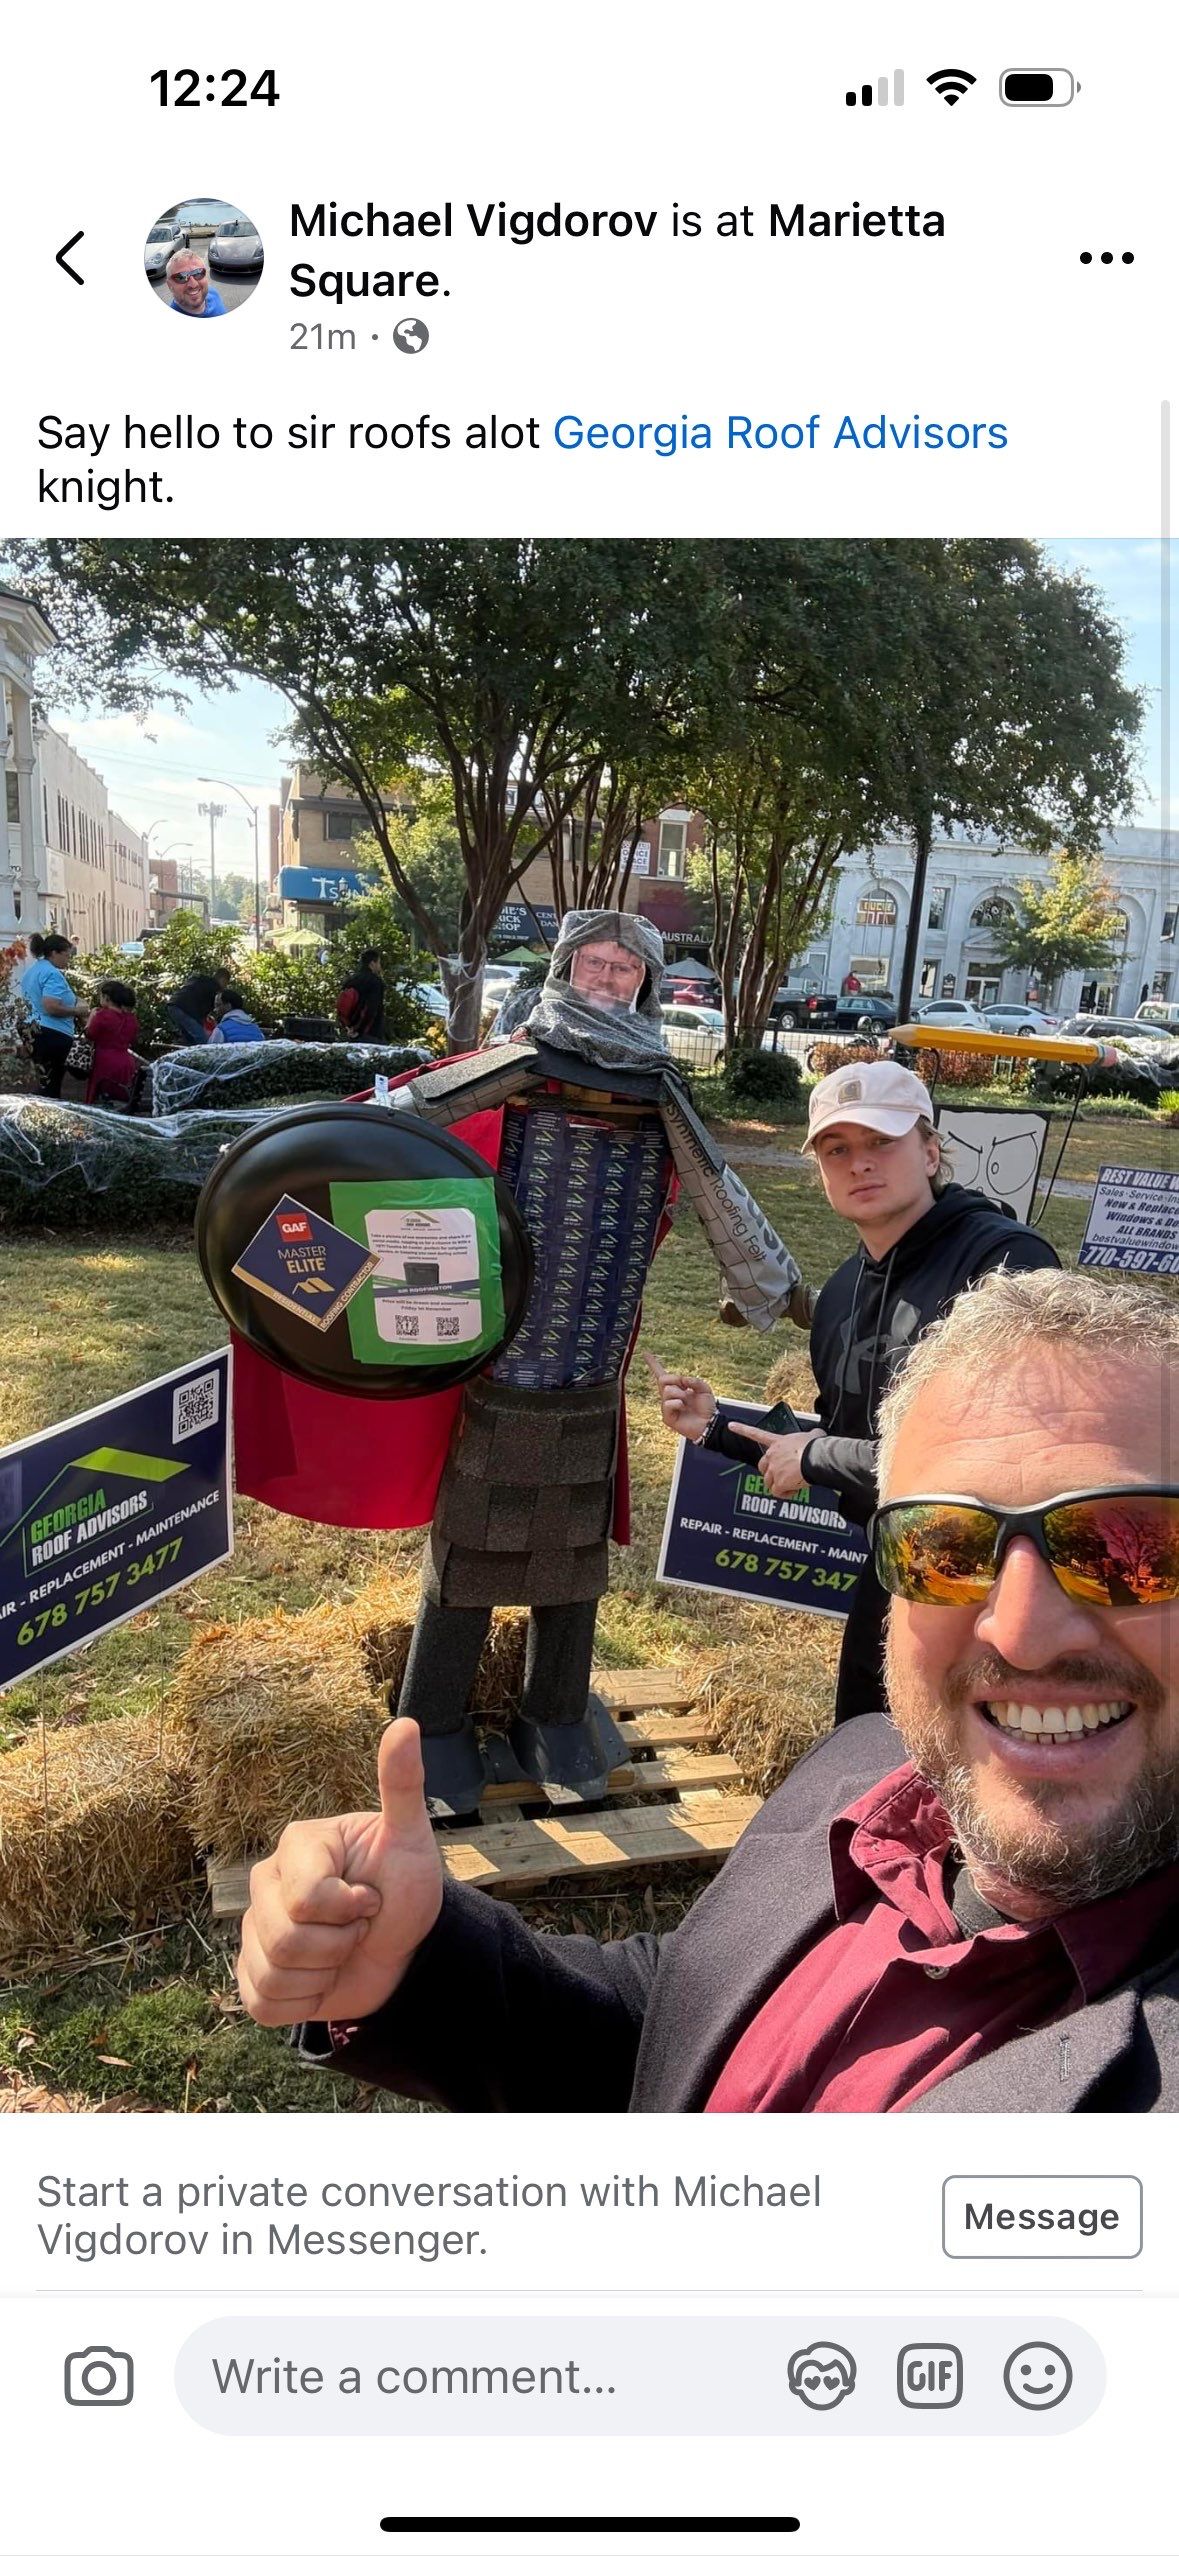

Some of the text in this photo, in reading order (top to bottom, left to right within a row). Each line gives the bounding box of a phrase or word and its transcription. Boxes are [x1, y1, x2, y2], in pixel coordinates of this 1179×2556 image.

[1099, 1186, 1124, 1197] Sales
[1129, 1190, 1163, 1201] Service
[1101, 1168, 1133, 1185] BEST
[1132, 1171, 1171, 1189] VALUE
[710, 1177, 748, 1237] Roofing
[744, 1235, 767, 1262] Felt
[1104, 1199, 1128, 1208] New
[1128, 1202, 1136, 1210] &
[1106, 1211, 1154, 1224] Windows
[1155, 1218, 1163, 1226] &
[281, 1222, 307, 1233] GAF
[1116, 1225, 1178, 1240] ALL BRANDS
[278, 1245, 327, 1259] MASTER
[286, 1258, 326, 1274] ELITE
[340, 1261, 374, 1301] CONTRACTOR
[31, 1488, 107, 1544] GEORGIA
[32, 1490, 148, 1567] ROOF ADVISORS
[741, 1494, 847, 1530] ROOF ADVISORS
[29, 1543, 126, 1603] REPLACEMENT
[136, 1490, 220, 1546] MAINTENANCE
[680, 1517, 723, 1535] REPAIR
[732, 1528, 819, 1554] REPLACEMENT
[715, 1549, 759, 1573] 678
[764, 1557, 809, 1582] 757
[17, 1536, 183, 1646] 678 757 3477
